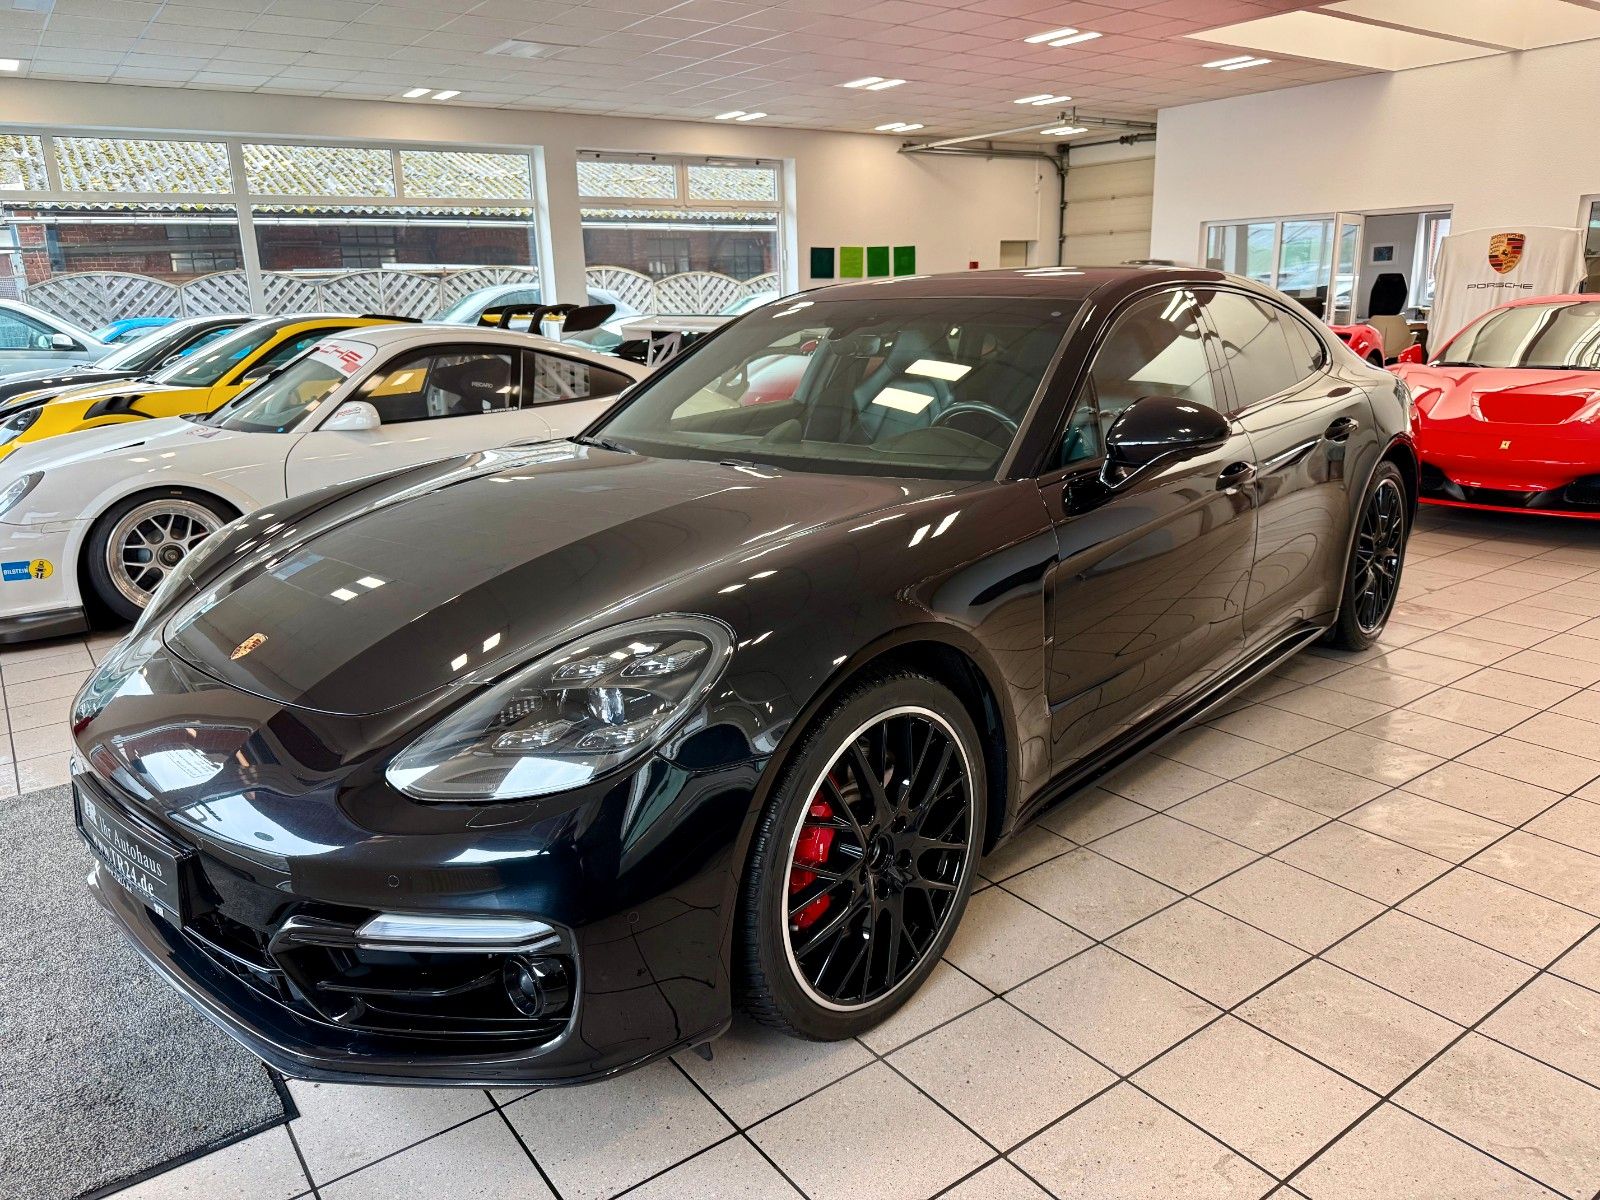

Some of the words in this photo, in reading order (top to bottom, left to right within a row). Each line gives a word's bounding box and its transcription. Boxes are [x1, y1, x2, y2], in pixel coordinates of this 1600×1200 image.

[1467, 282, 1533, 290] PORSCHE
[3, 567, 29, 576] BILSTEIN
[99, 816, 112, 840] Ihr
[114, 830, 163, 877] Autohaus
[92, 832, 154, 897] www.TR24.de
